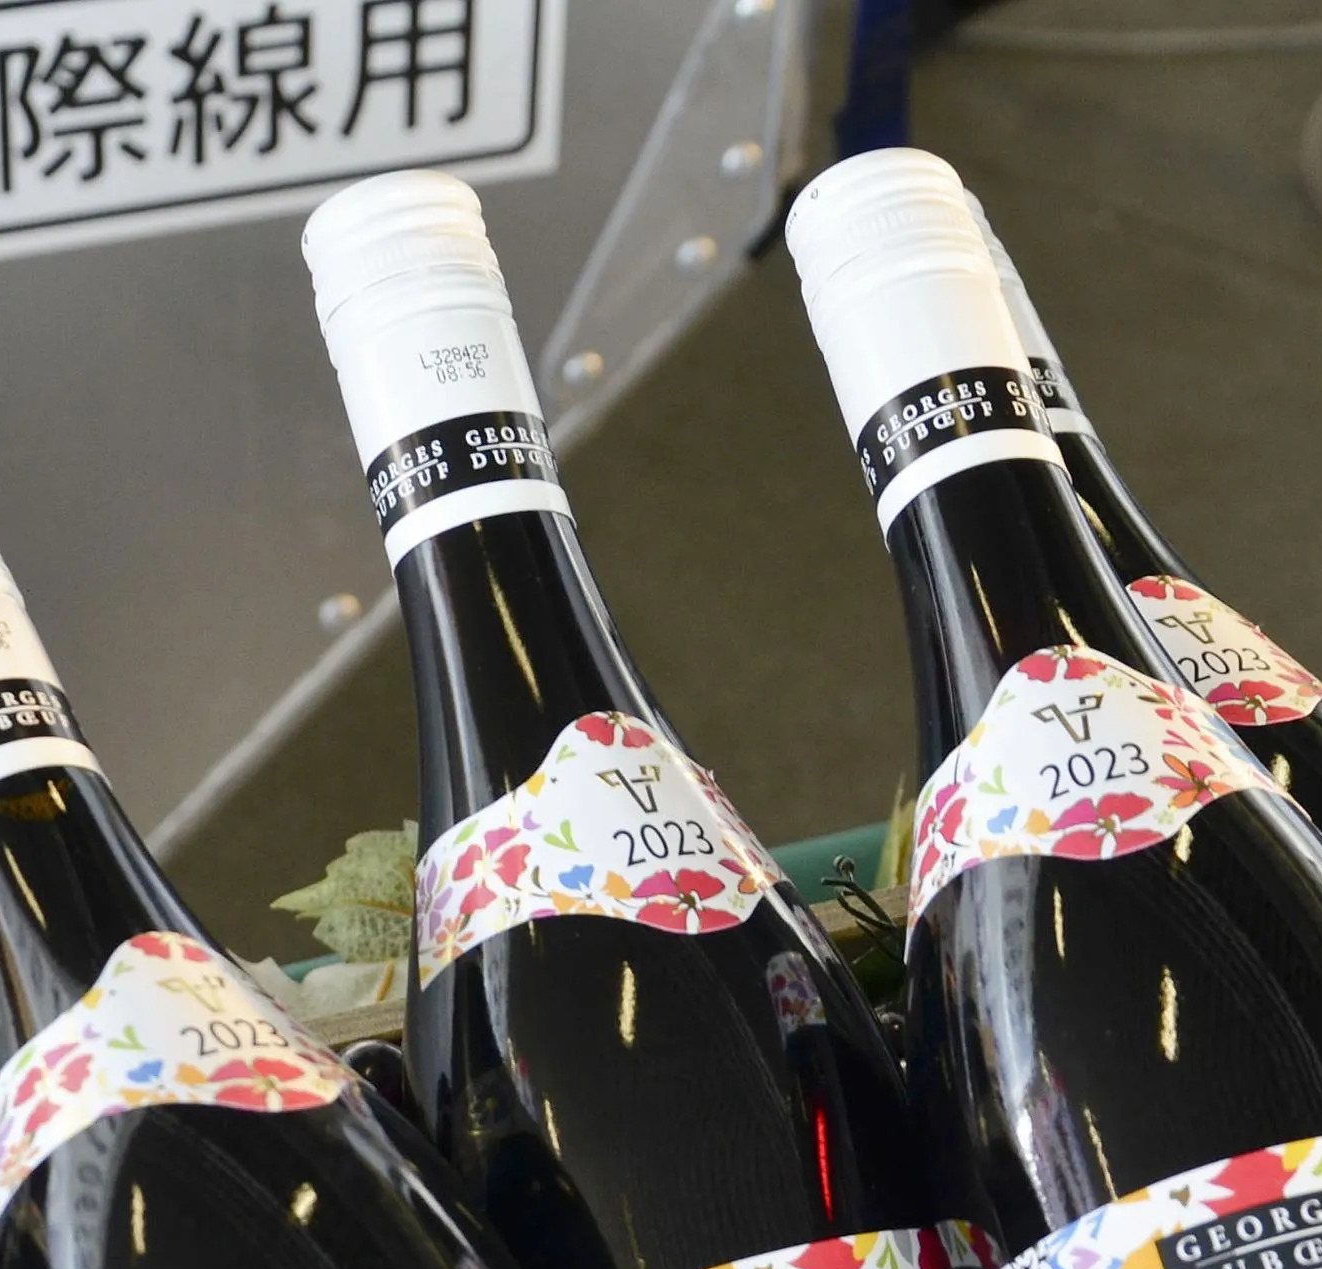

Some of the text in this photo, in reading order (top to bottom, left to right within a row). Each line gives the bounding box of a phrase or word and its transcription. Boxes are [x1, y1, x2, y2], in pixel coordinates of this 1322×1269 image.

[419, 344, 489, 369] L328423
[436, 361, 486, 384] 08:56
[877, 381, 986, 442] GEORGES
[1177, 648, 1270, 684] 2023
[1040, 743, 1150, 799] 2023
[613, 821, 714, 867] 2023
[182, 1020, 289, 1056] 2023
